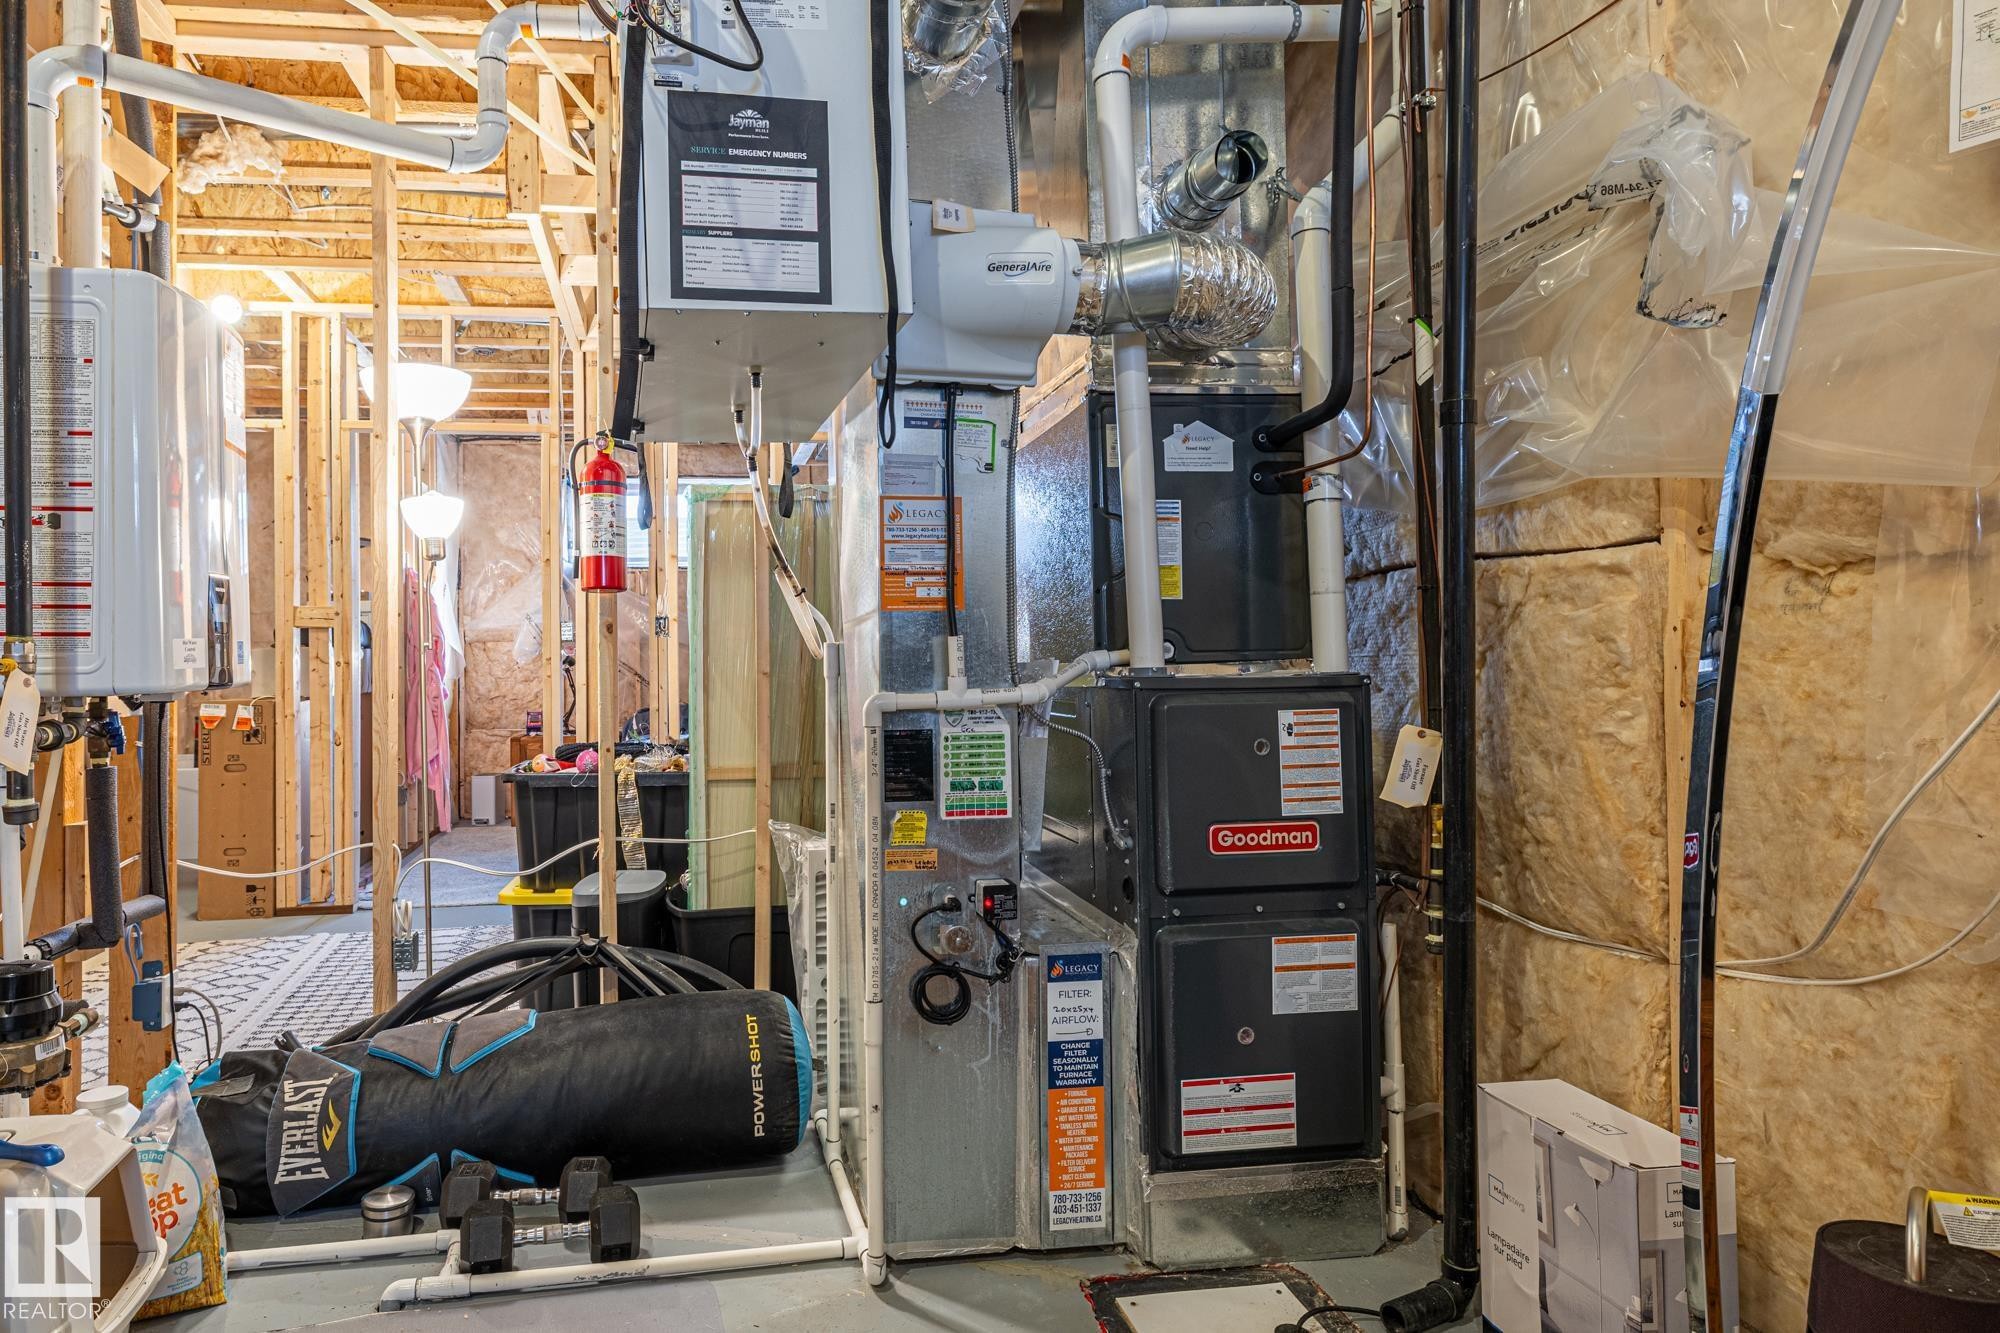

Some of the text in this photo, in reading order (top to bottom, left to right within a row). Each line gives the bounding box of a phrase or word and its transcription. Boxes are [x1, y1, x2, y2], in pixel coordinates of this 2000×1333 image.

[728, 113, 770, 130] Jayman
[690, 146, 808, 160] SERVICE EMERGENCY NUMBERS
[987, 261, 1052, 273] GeneralAire
[1419, 764, 1429, 785] Furnace
[1217, 829, 1313, 848] Goodman
[872, 912, 878, 921] IN
[1065, 963, 1099, 973] LEGACY
[1058, 989, 1092, 999] FILTER:
[1051, 1014, 1099, 1025] AIRFLOW:
[1060, 1042, 1091, 1050] CHANGE
[1064, 1049, 1088, 1057] FILTER
[1052, 1056, 1099, 1065] SEASONALLY
[1064, 1063, 1099, 1072] MAINTAIN
[745, 1014, 766, 1138] POWERSHOT
[1059, 1071, 1093, 1079] FURNACE
[1055, 1078, 1097, 1087] WARRANTY
[1078, 1105, 1096, 1113] HEATER
[1068, 1114, 1083, 1122] WATER
[1059, 1121, 1097, 1130] TANKLESS WATER
[273, 1078, 335, 1185] EVERLAST
[1063, 1144, 1095, 1152] MAINTENANCE
[1060, 1158, 1096, 1167] FILTER DELIVERY
[1076, 1180, 1095, 1188] SERVICE
[1053, 1192, 1102, 1205] 780-733-1256
[1053, 1202, 1102, 1215] 403-451-1337
[1053, 1214, 1102, 1226] LEGACYHEATING.CA
[1487, 1225, 1530, 1264] Lampadaire
[1493, 1243, 1523, 1270] sur pied
